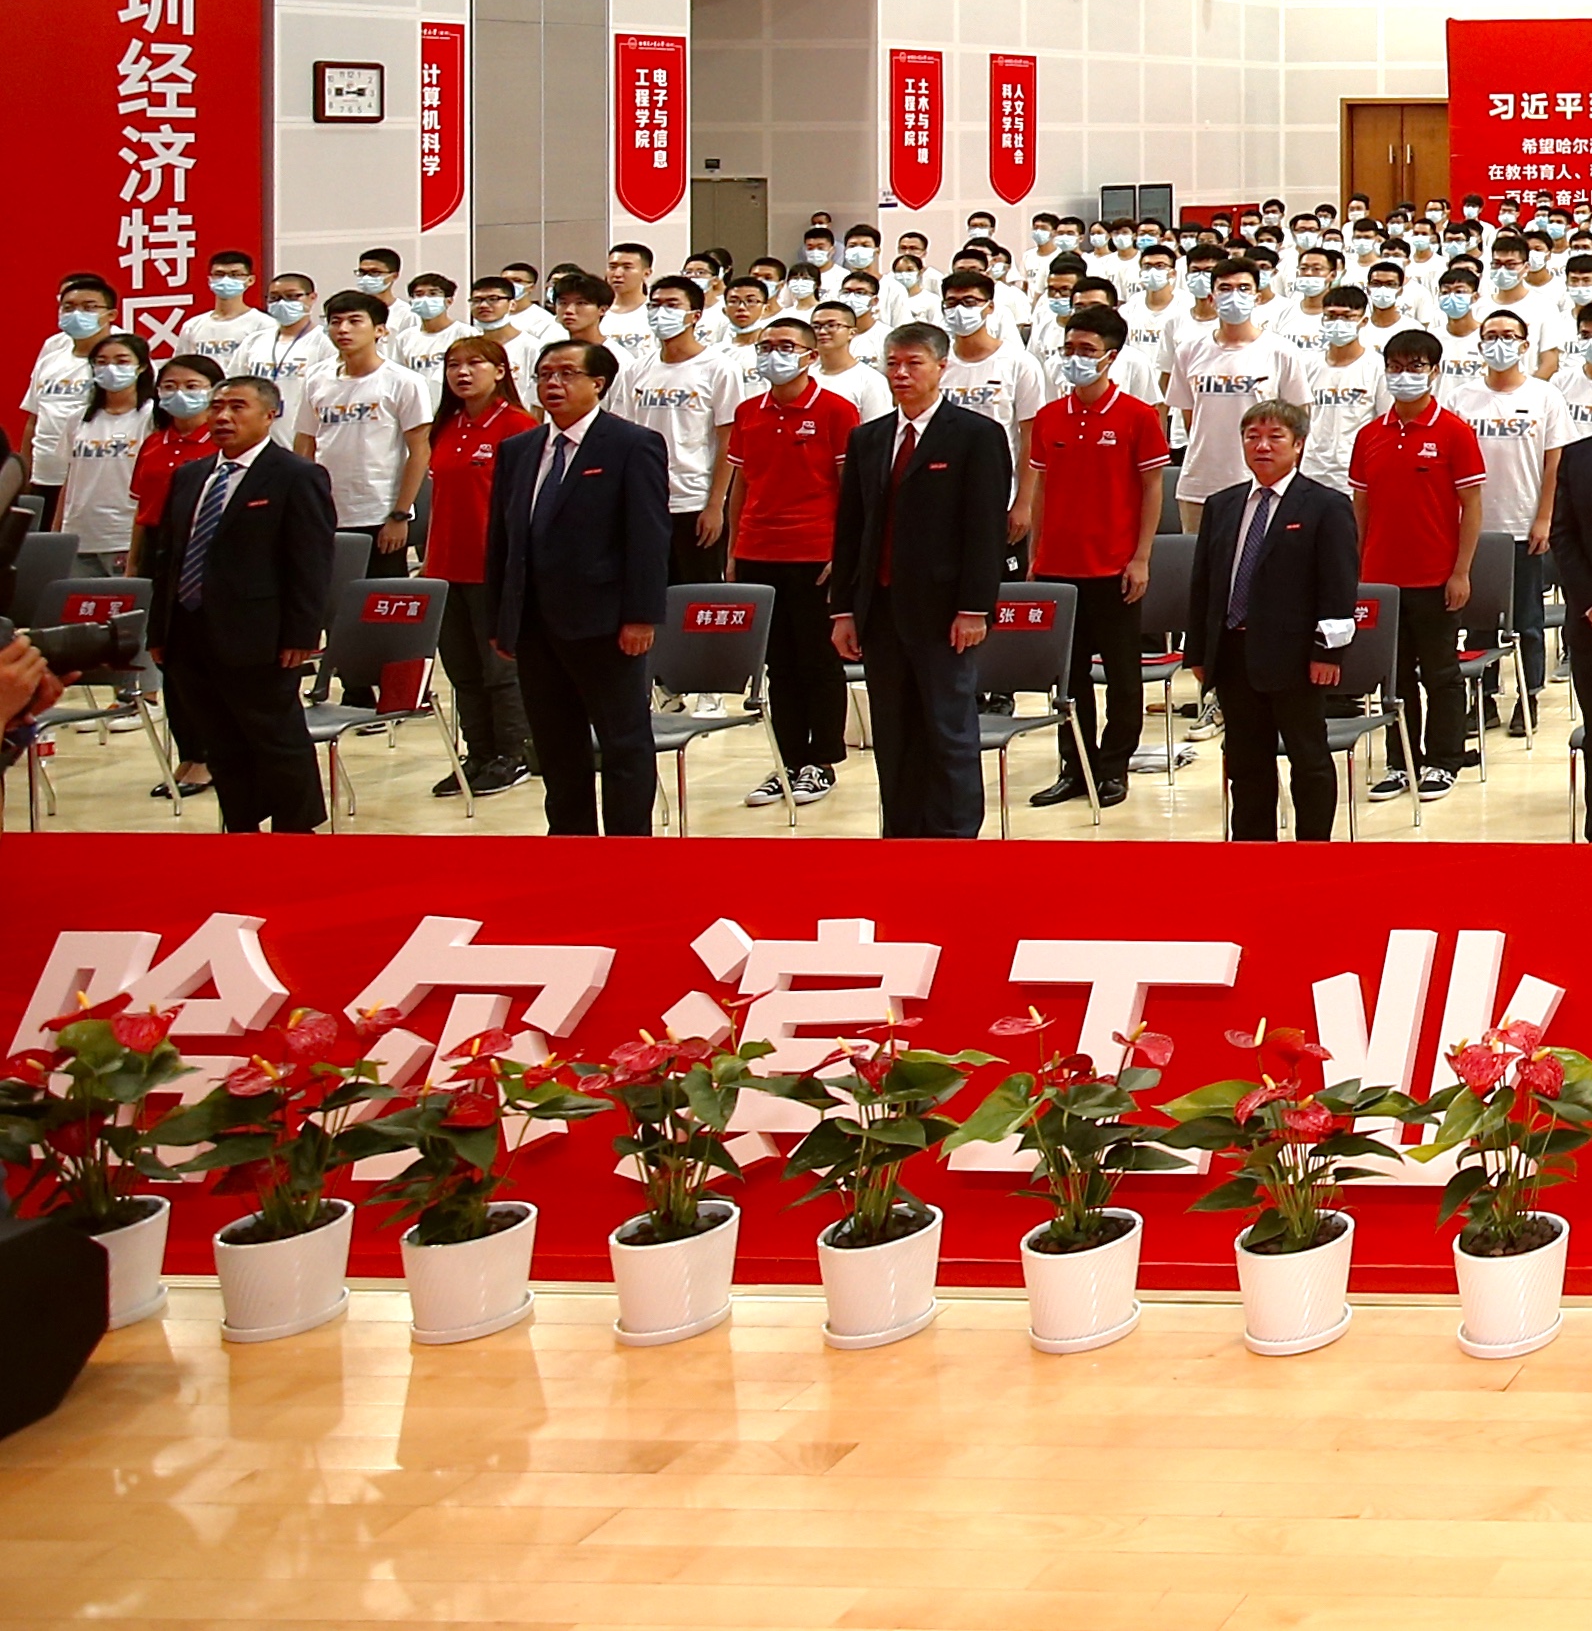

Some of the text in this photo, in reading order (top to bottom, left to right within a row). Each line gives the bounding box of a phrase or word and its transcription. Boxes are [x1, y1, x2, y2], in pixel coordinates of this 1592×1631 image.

[422, 63, 441, 177] 计算机科学
[634, 68, 651, 149] 工程学院
[652, 68, 668, 169] 电子与信息
[904, 77, 917, 148] 工程学院
[917, 77, 930, 165] 土木与环境
[1013, 82, 1025, 166] 人文与社会
[374, 600, 421, 617] 马广富
[695, 609, 746, 626] 韩喜双
